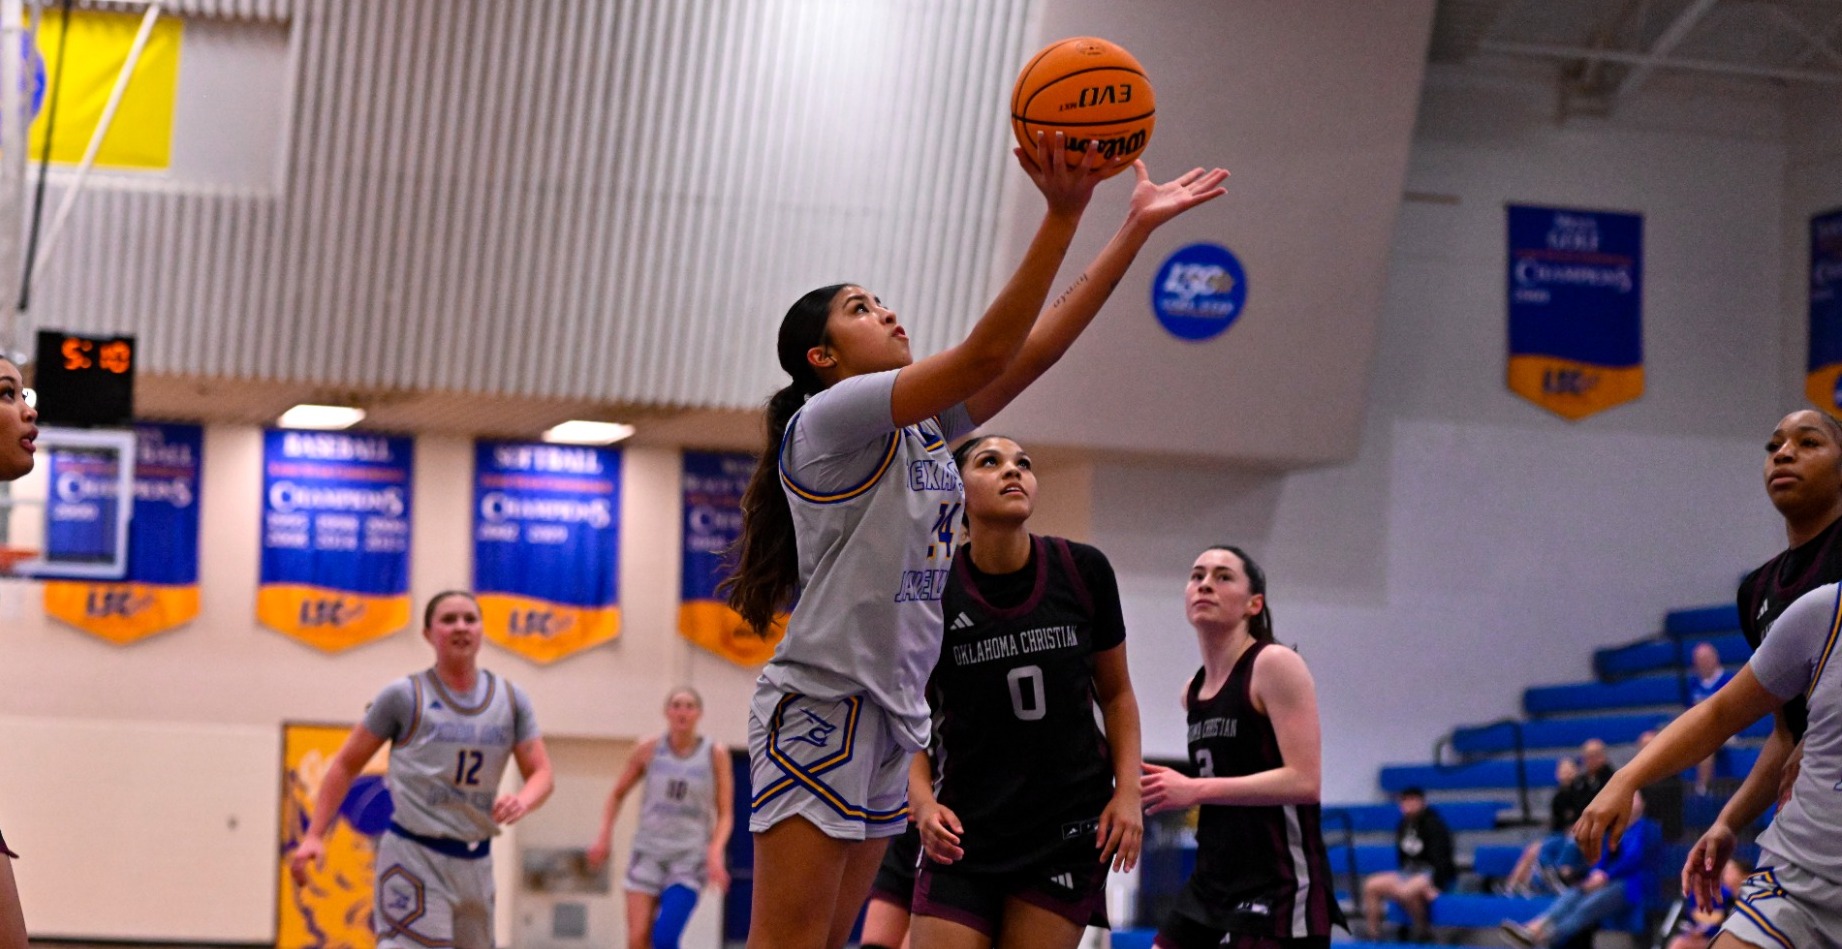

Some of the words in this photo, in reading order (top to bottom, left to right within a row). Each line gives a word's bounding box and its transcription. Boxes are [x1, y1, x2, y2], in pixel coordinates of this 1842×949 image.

[1079, 84, 1132, 108] EVO
[953, 634, 1018, 666] OKLAHOMA
[1020, 625, 1078, 653] CHRISTIAN
[1007, 665, 1046, 721] 0
[454, 749, 484, 786] 12
